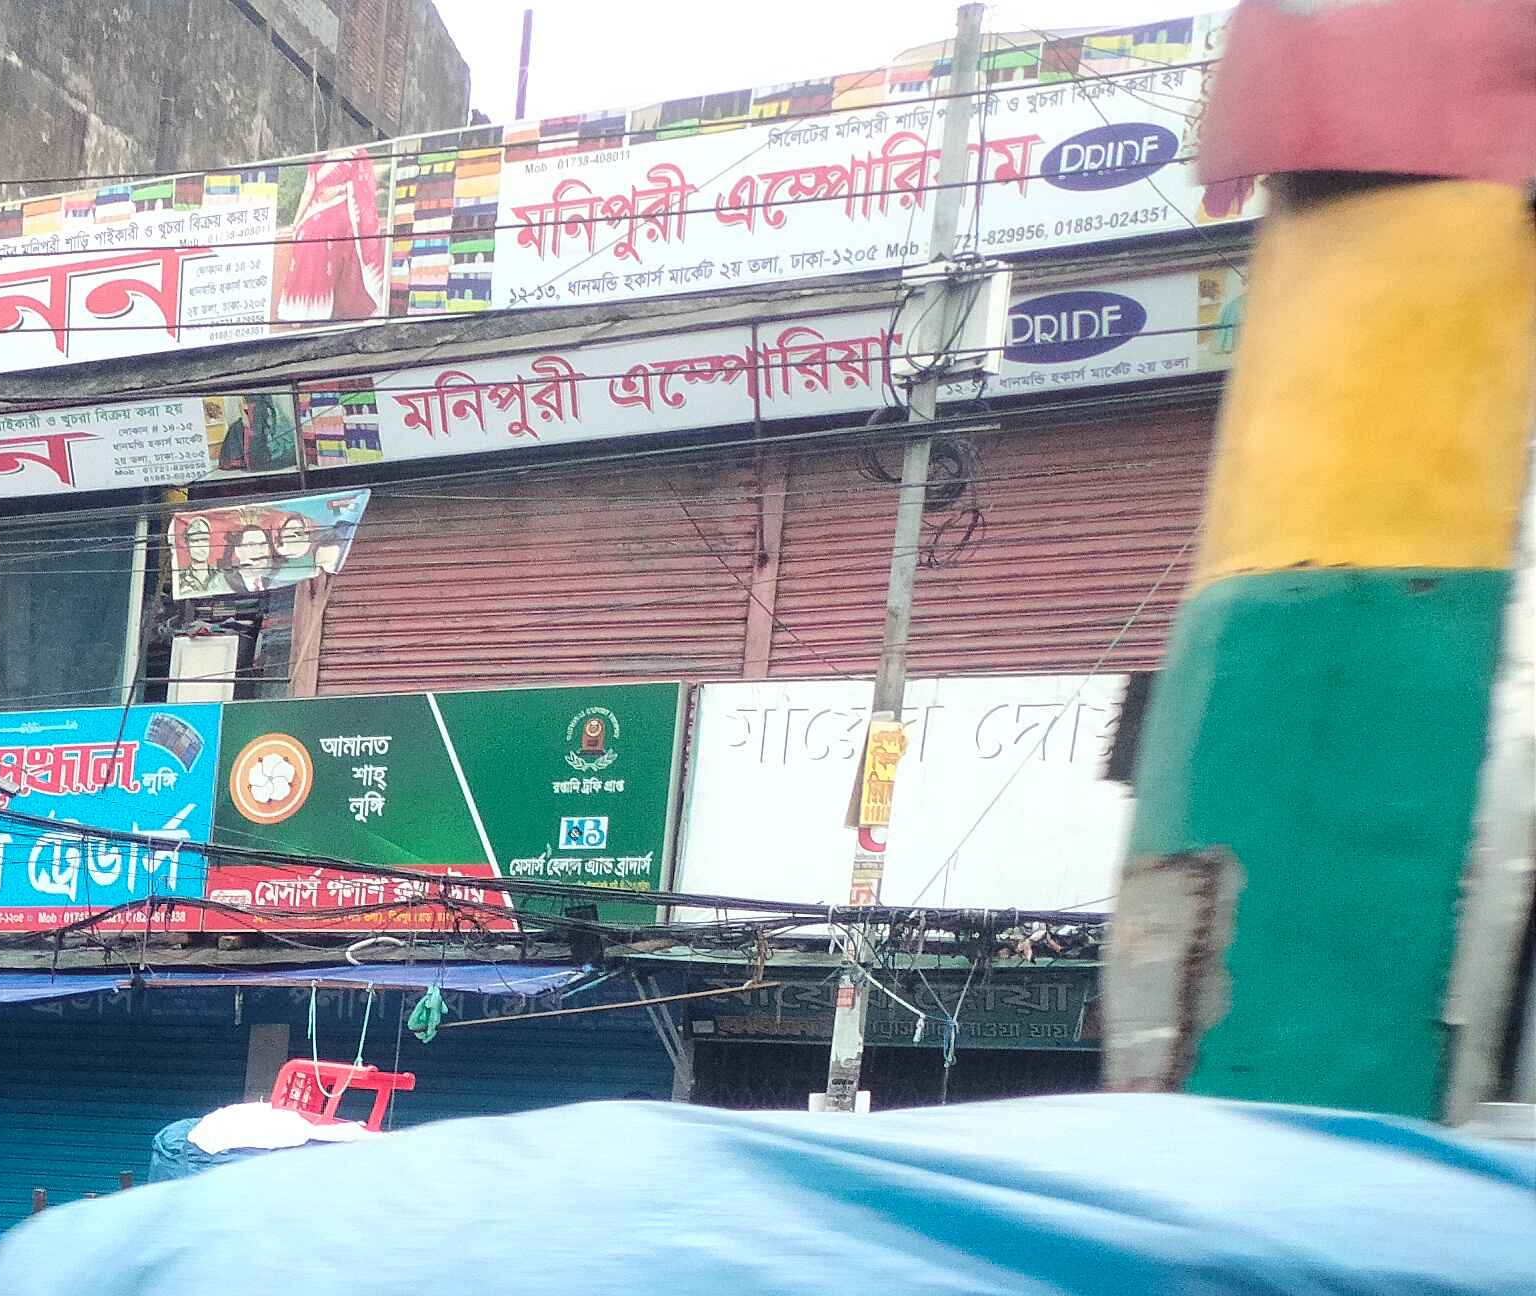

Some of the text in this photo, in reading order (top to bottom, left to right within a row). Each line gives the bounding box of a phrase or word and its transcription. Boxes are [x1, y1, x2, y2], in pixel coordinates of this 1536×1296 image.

[510, 162, 701, 265] মনিপুরী
[669, 260, 714, 284] মার্কেট
[392, 355, 586, 440] মনিপুরী
[135, 404, 161, 418] করা
[319, 735, 393, 757] আমানত
[351, 765, 388, 791] শাহ্
[348, 791, 386, 823] লুঙ্গি
[509, 851, 546, 876] মেসার্স
[615, 851, 654, 877] ব্রাদার্স
[254, 867, 322, 908] মেসার্স
